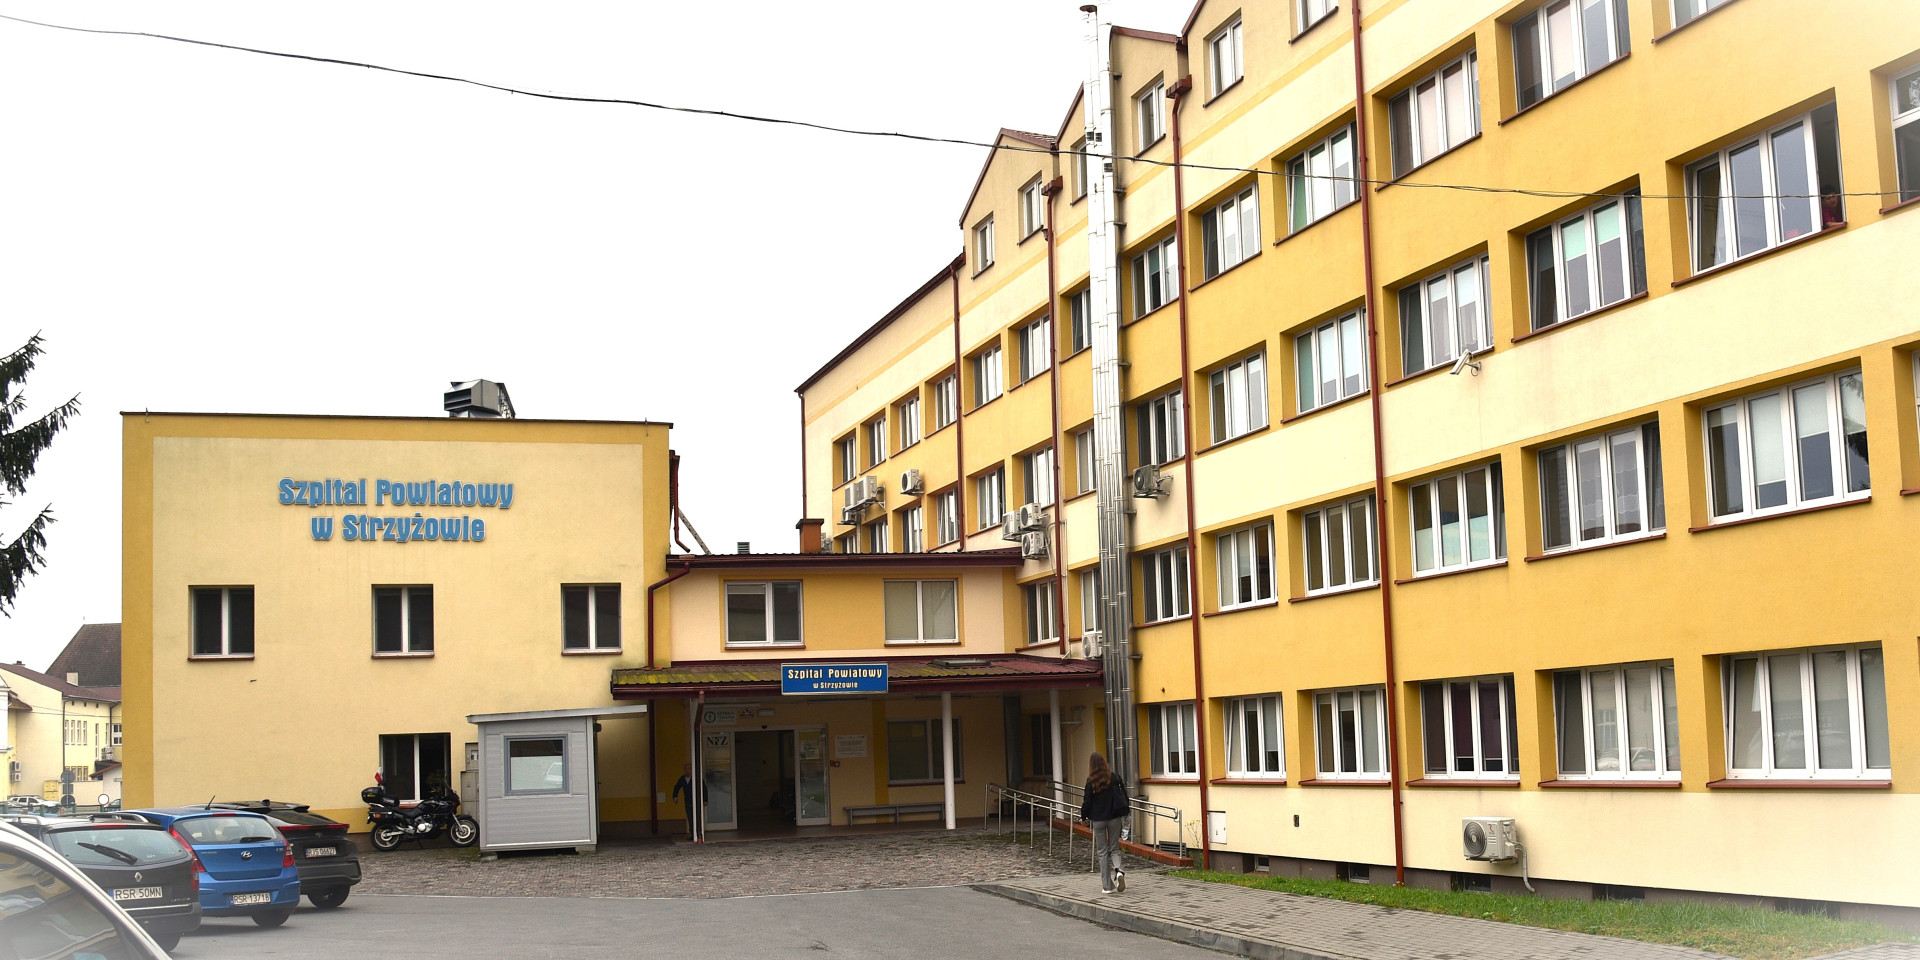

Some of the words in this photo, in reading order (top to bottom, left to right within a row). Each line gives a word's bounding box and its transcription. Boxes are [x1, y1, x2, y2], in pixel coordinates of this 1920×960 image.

[278, 477, 367, 508] Szpital
[375, 479, 515, 509] Powiatowy
[311, 515, 334, 541] w
[342, 513, 486, 543] Strzyżowie
[788, 669, 823, 679] Szpital
[828, 668, 883, 679] Powiatowy
[115, 889, 136, 899] RSR
[138, 887, 162, 898] 50MN
[233, 895, 248, 904] RSR
